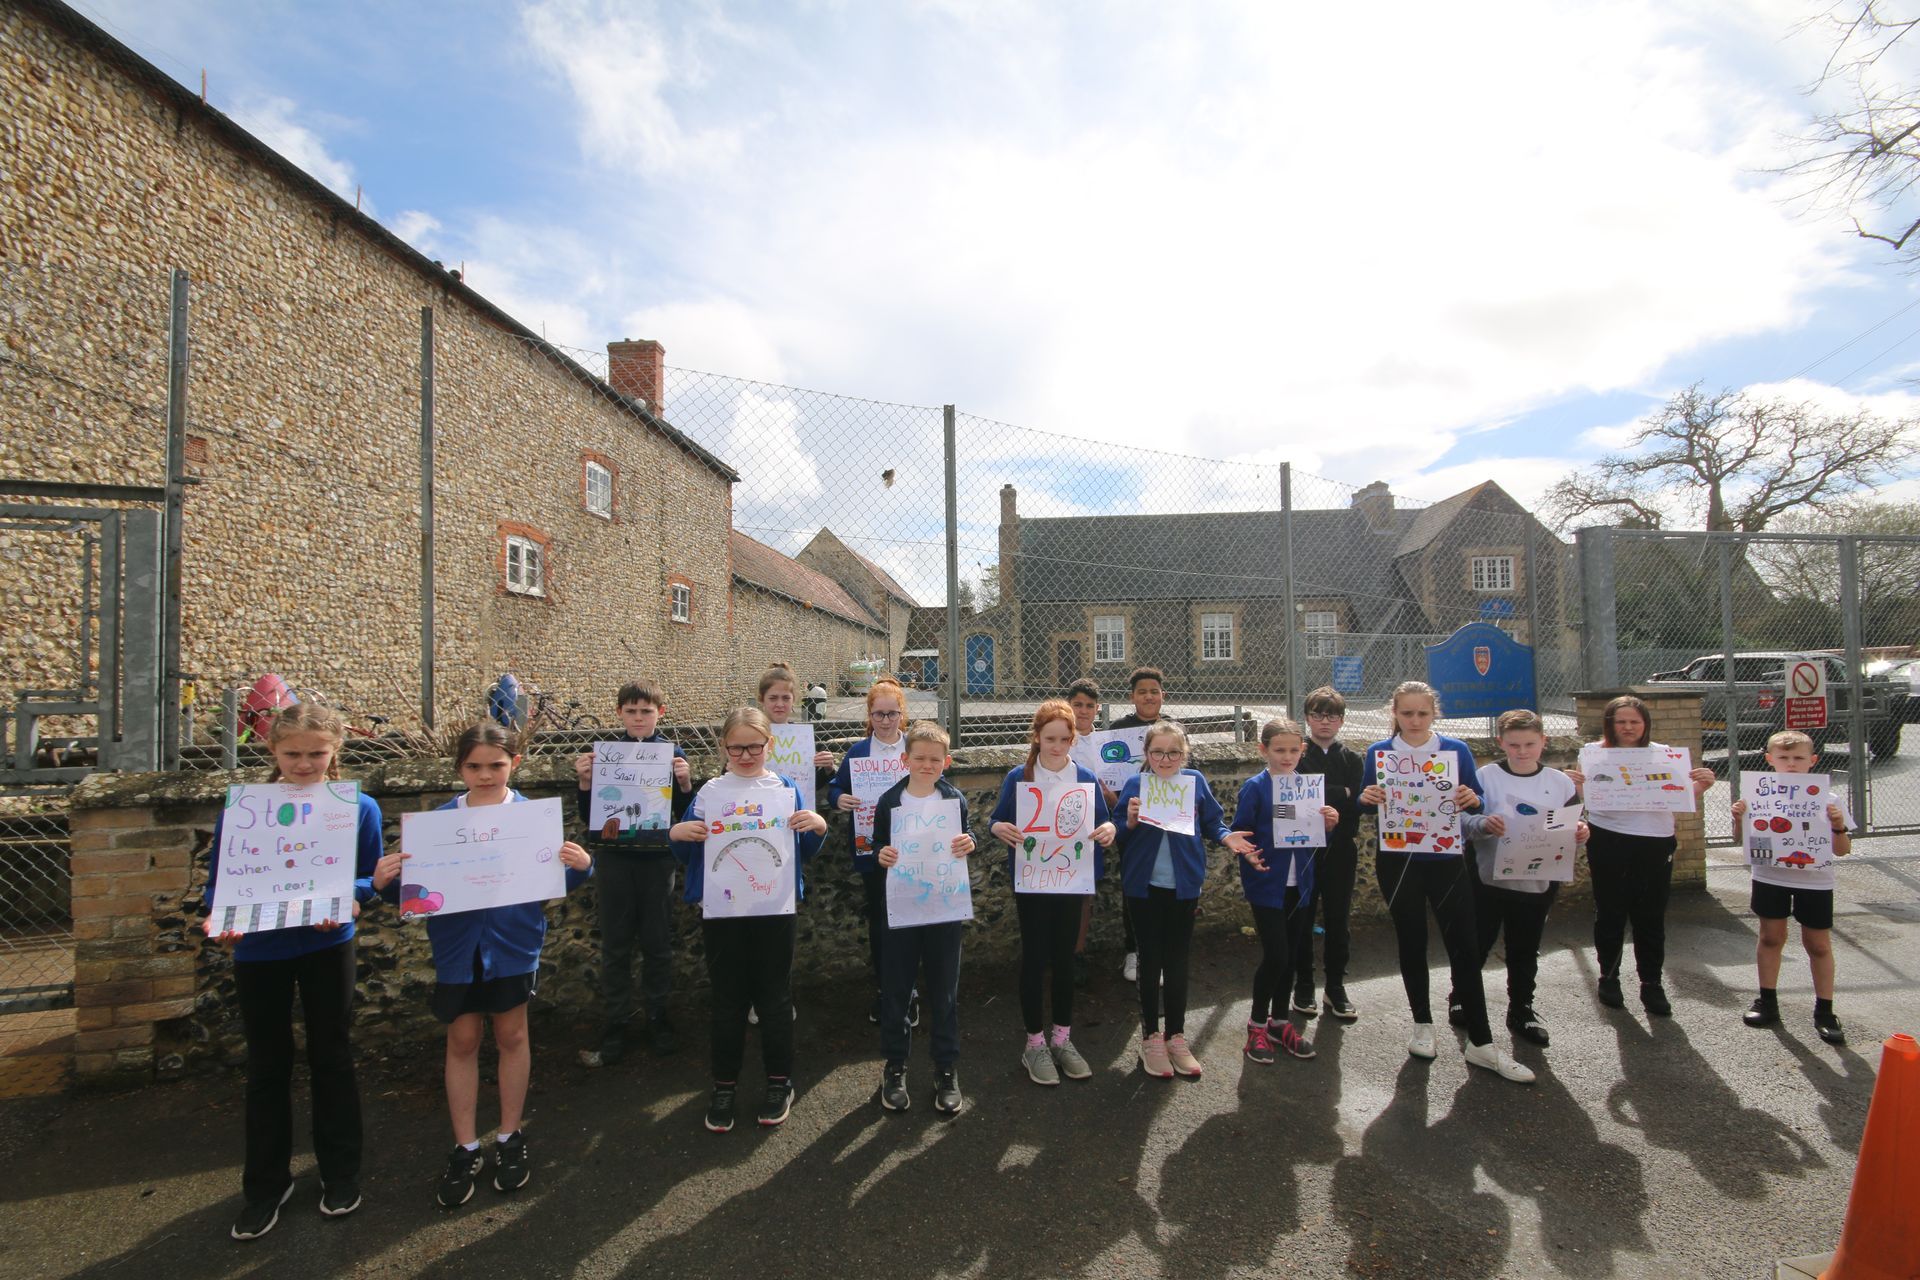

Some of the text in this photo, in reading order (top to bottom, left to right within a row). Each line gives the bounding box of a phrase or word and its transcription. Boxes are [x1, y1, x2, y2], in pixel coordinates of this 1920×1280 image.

[599, 743, 659, 767] Stop think
[853, 759, 879, 773] SLOW
[614, 768, 636, 782] Snail
[1279, 775, 1323, 790] SLOW
[1386, 777, 1424, 788] ahead
[1756, 776, 1801, 800] Stop
[722, 800, 763, 817] Going
[1022, 787, 1088, 840] 20
[227, 836, 320, 857] the fear
[932, 841, 945, 853] a
[1782, 837, 1795, 846] 20
[226, 863, 272, 876] when
[285, 858, 298, 869] a
[1021, 864, 1077, 889] PLENTY
[238, 879, 314, 898] is near!
